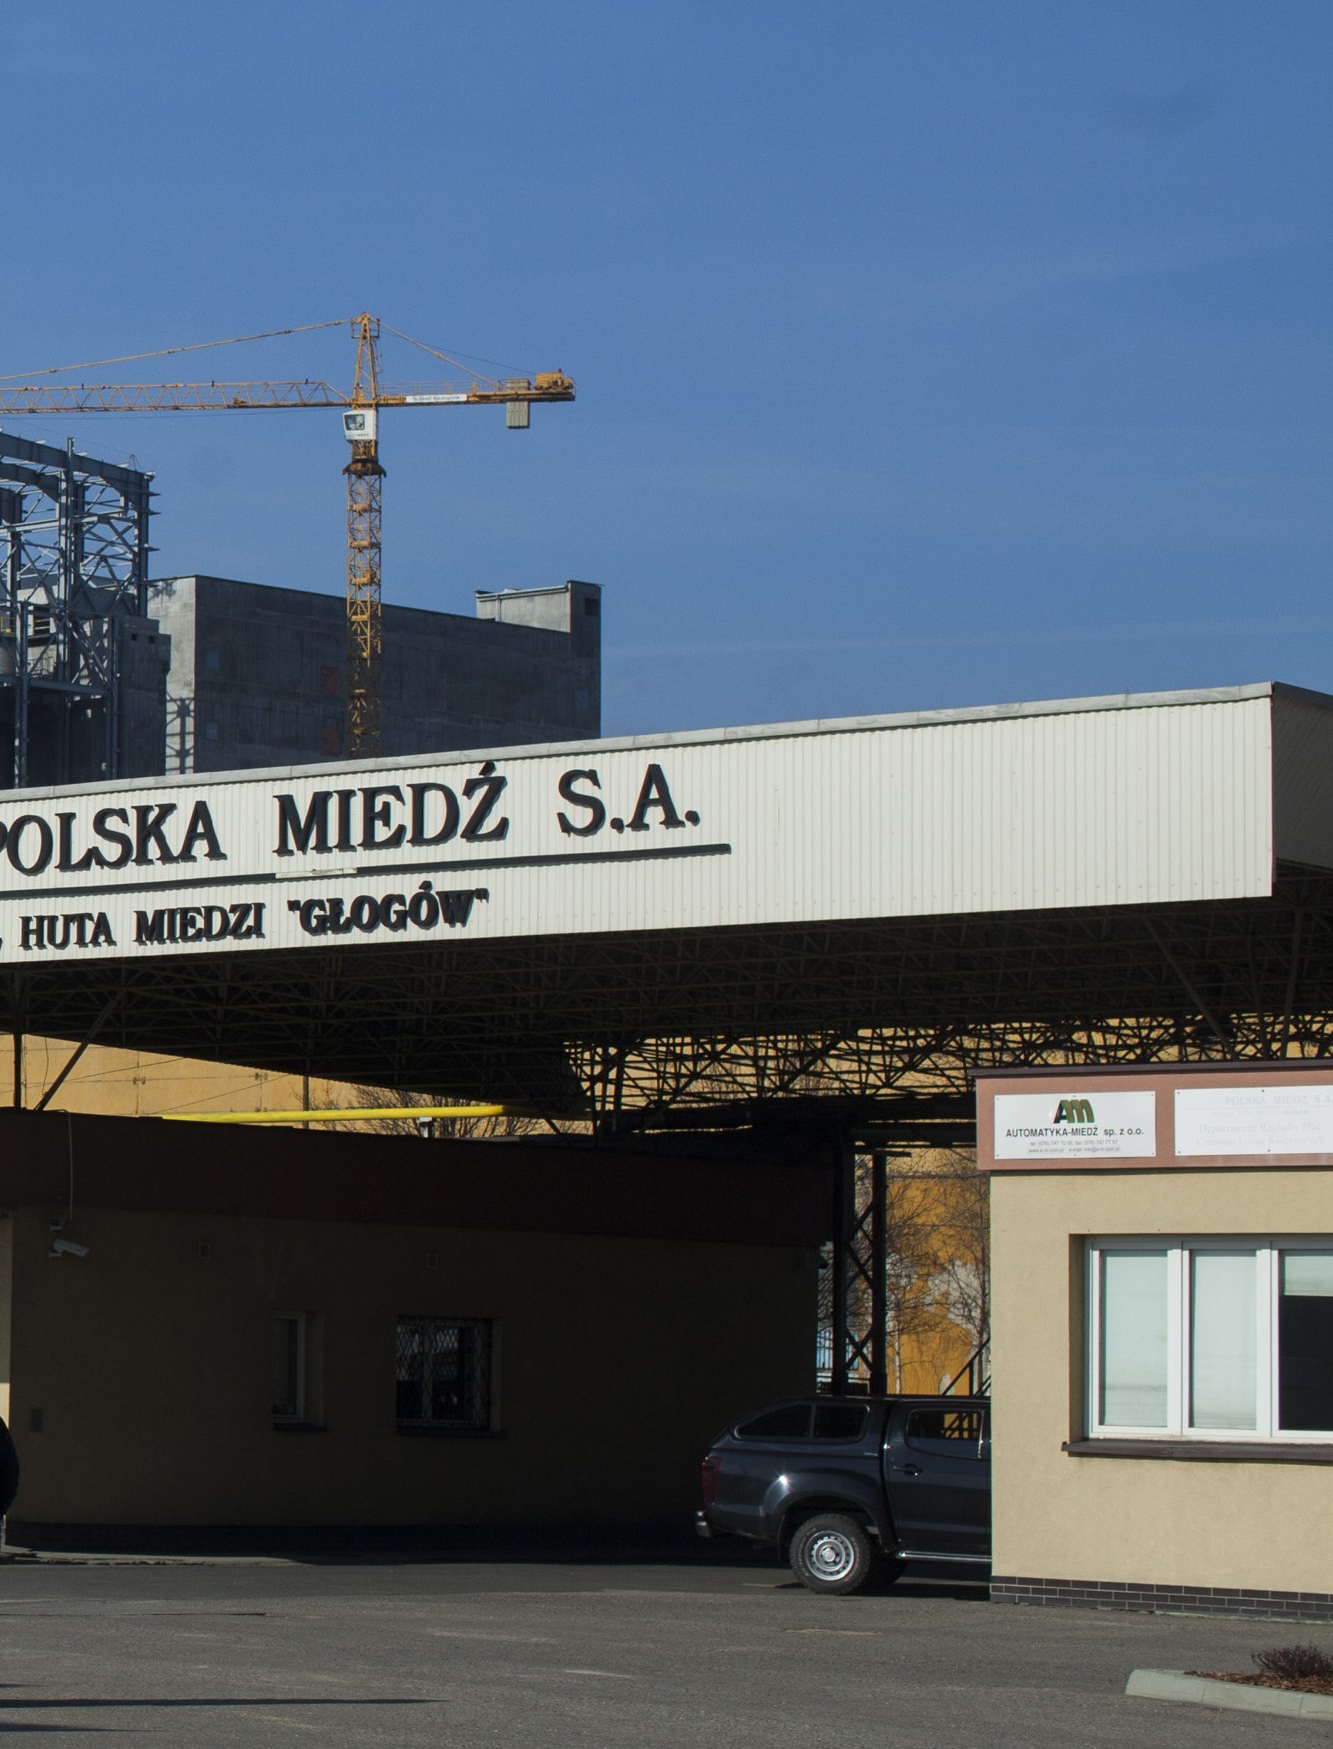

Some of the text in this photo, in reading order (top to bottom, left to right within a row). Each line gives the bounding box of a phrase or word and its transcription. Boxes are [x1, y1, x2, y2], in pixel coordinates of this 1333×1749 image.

[272, 761, 510, 857] MIEDŹ
[556, 763, 701, 838] S.A.
[19, 912, 117, 951] HUTA
[133, 902, 266, 946] MIEDZI
[287, 880, 490, 937] "GŁOGÓW"
[1006, 1126, 1098, 1138] AUTOMATYKA-MIEDŹ
[1103, 1130, 1117, 1138] sp.
[1127, 1128, 1144, 1136] o.o.
